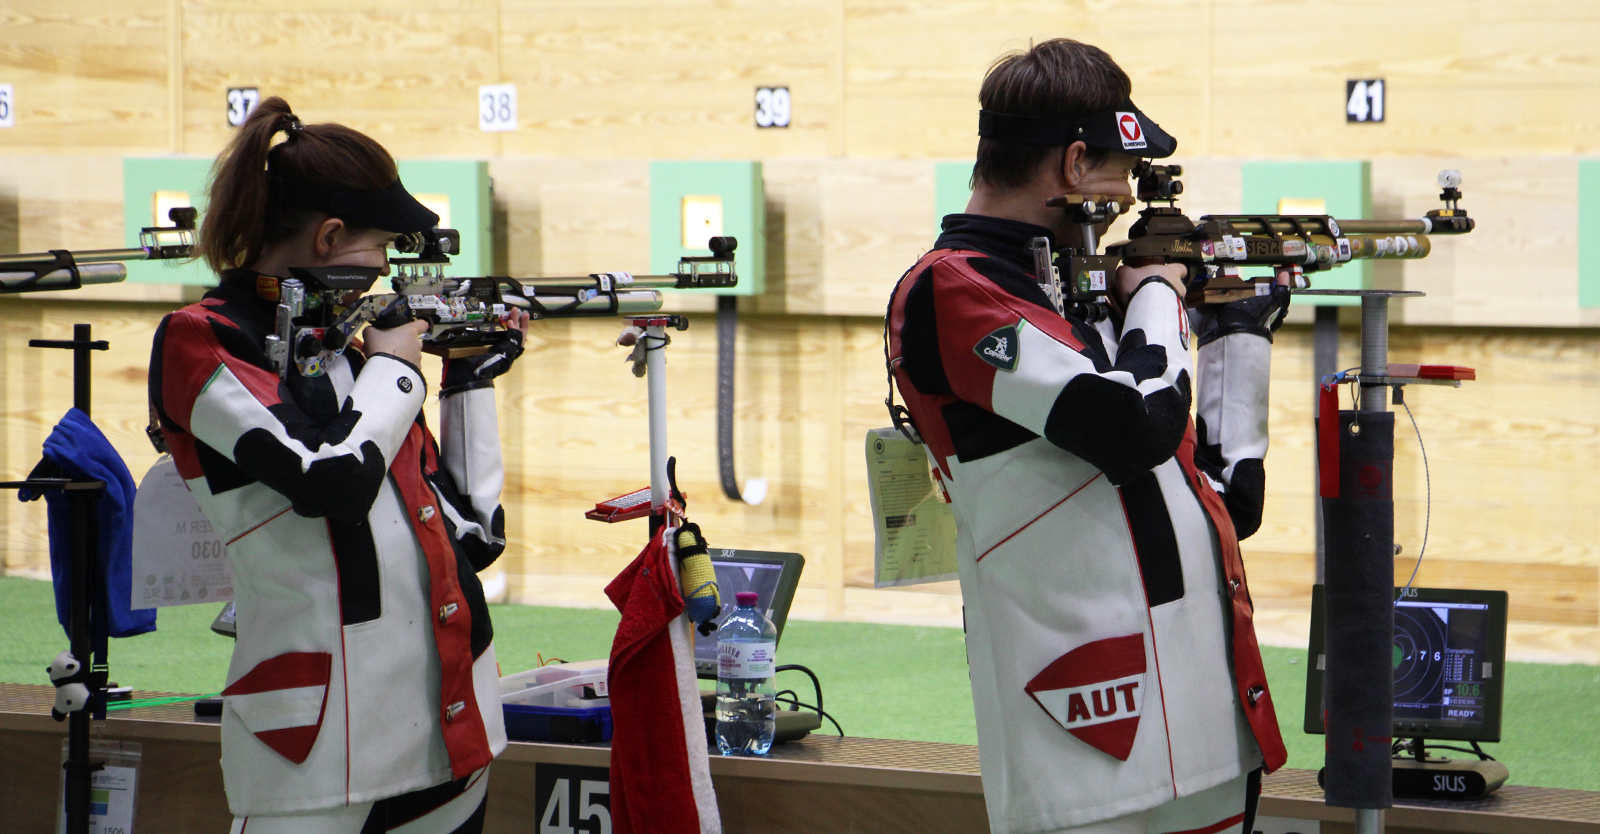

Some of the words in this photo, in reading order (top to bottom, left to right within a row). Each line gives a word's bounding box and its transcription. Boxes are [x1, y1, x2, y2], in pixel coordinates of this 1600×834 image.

[227, 89, 259, 126] 37
[482, 92, 511, 123] 38
[755, 88, 790, 127] 39
[1347, 80, 1383, 122] 41
[1247, 240, 1279, 255] STEYR
[720, 549, 736, 558] SIUS
[1400, 587, 1418, 598] SIUS
[1420, 651, 1427, 660] 7
[1433, 651, 1441, 661] 6
[1456, 683, 1480, 697] 10.6
[1067, 681, 1139, 723] AUT
[1447, 709, 1475, 718] READY
[1433, 774, 1466, 792] SIUS
[540, 778, 613, 834] 45
